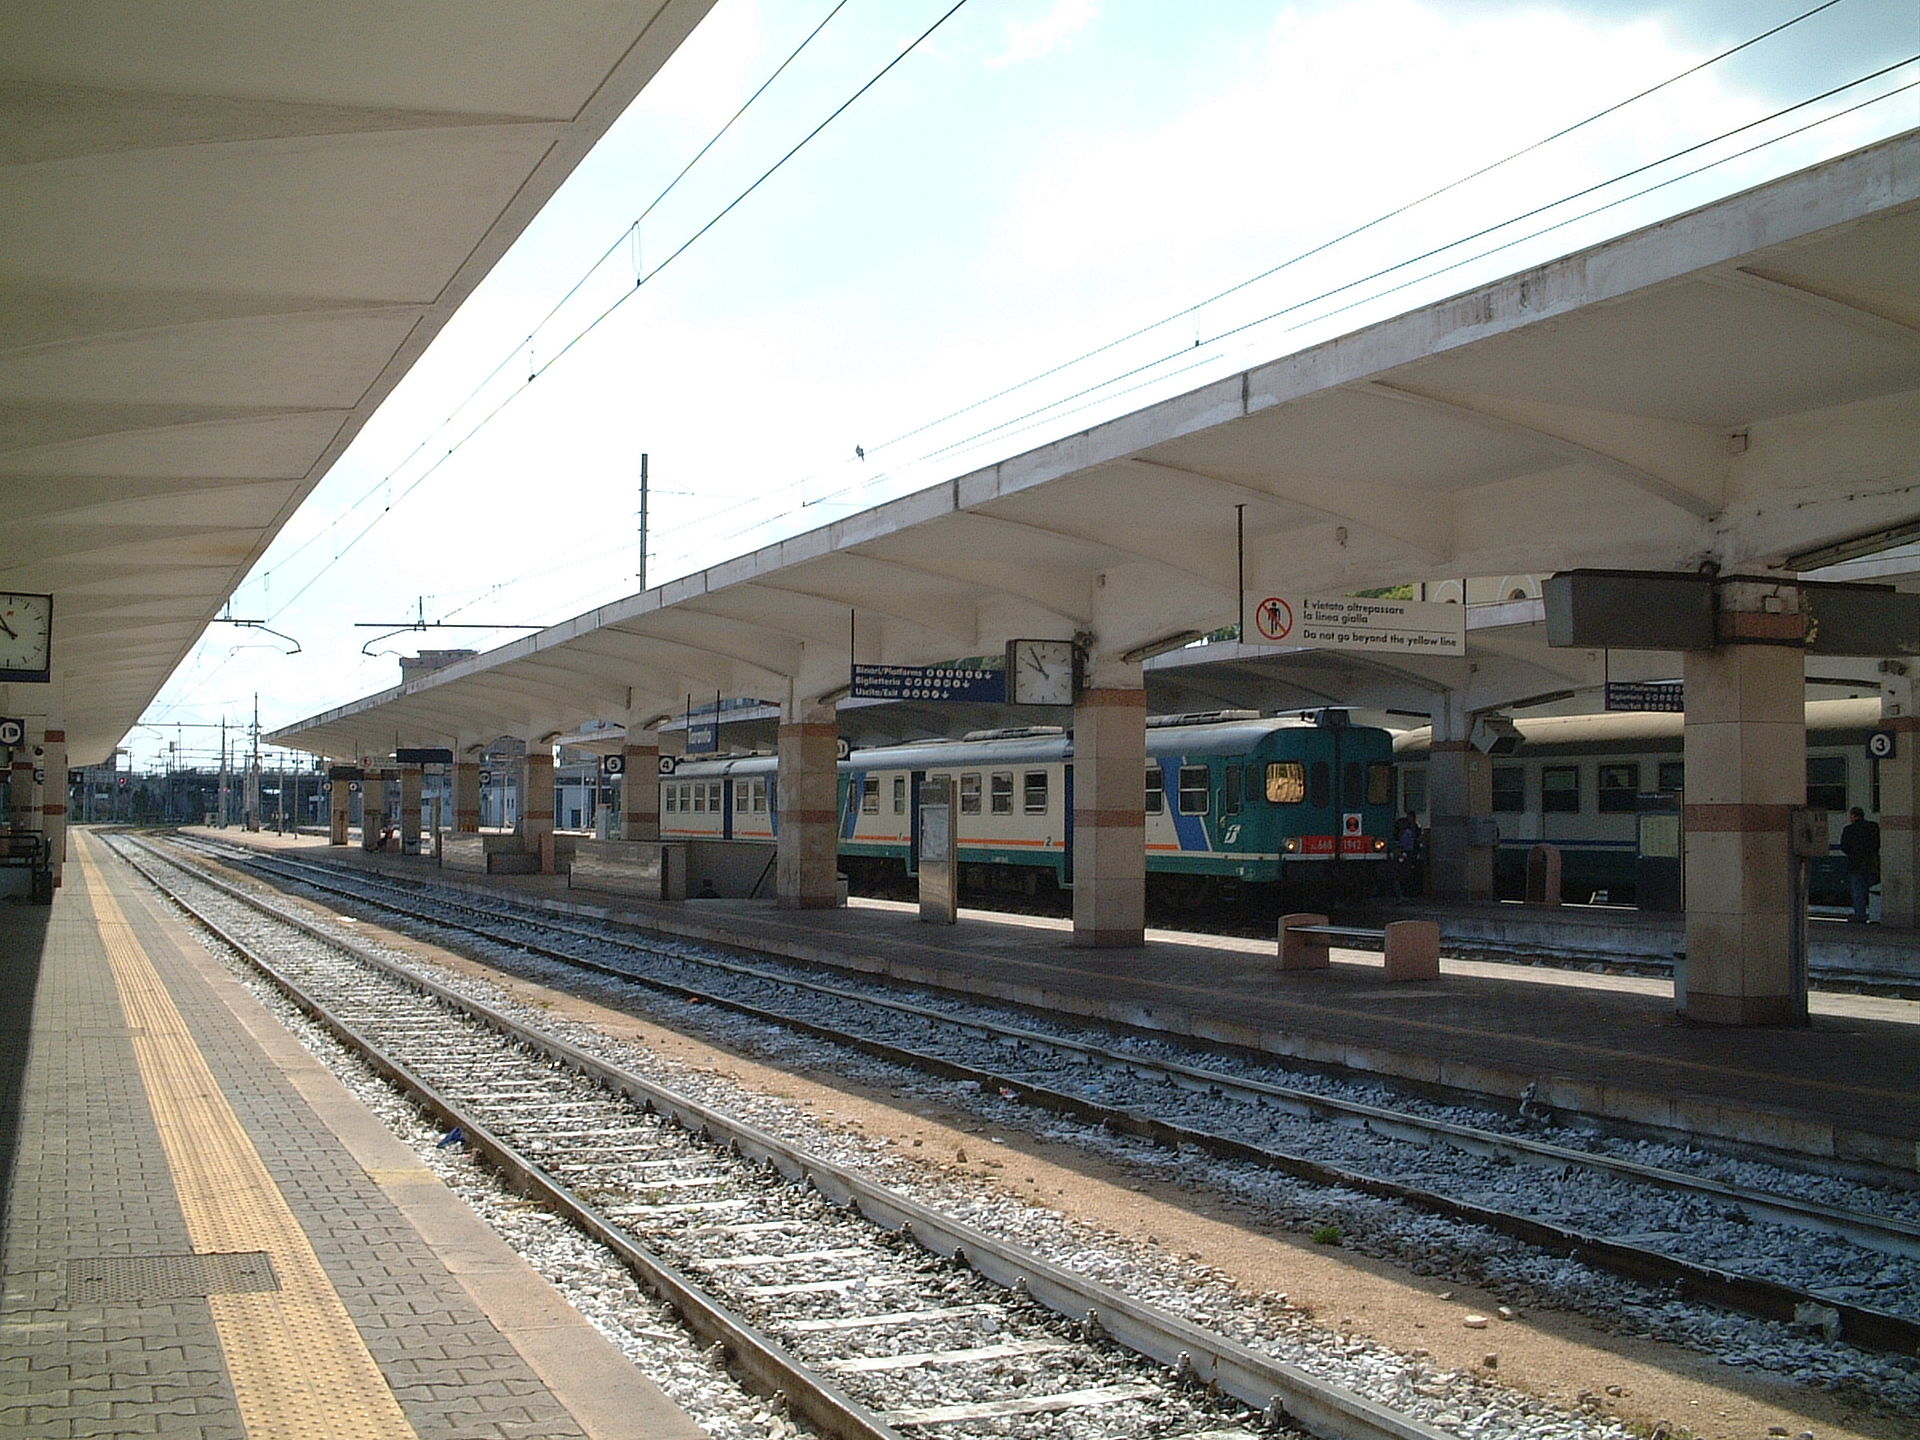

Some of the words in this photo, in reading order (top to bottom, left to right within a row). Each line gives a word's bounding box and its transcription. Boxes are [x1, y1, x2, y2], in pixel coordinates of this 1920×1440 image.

[1312, 600, 1344, 611] vietato
[1347, 603, 1405, 615] oltrepassare
[1303, 610, 1313, 620] la
[1315, 611, 1339, 622] linea
[1341, 613, 1368, 625] gialla
[1303, 629, 1317, 639] Do
[1319, 631, 1335, 641] not
[1337, 634, 1350, 643] go
[1352, 632, 1388, 644] beyond
[1390, 634, 1405, 644] the
[1407, 636, 1438, 647] yellow
[1440, 636, 1457, 647] line
[1876, 738, 1885, 751] 3
[610, 759, 618, 770] 5
[662, 760, 670, 770] 4
[1045, 835, 1052, 846] 2
